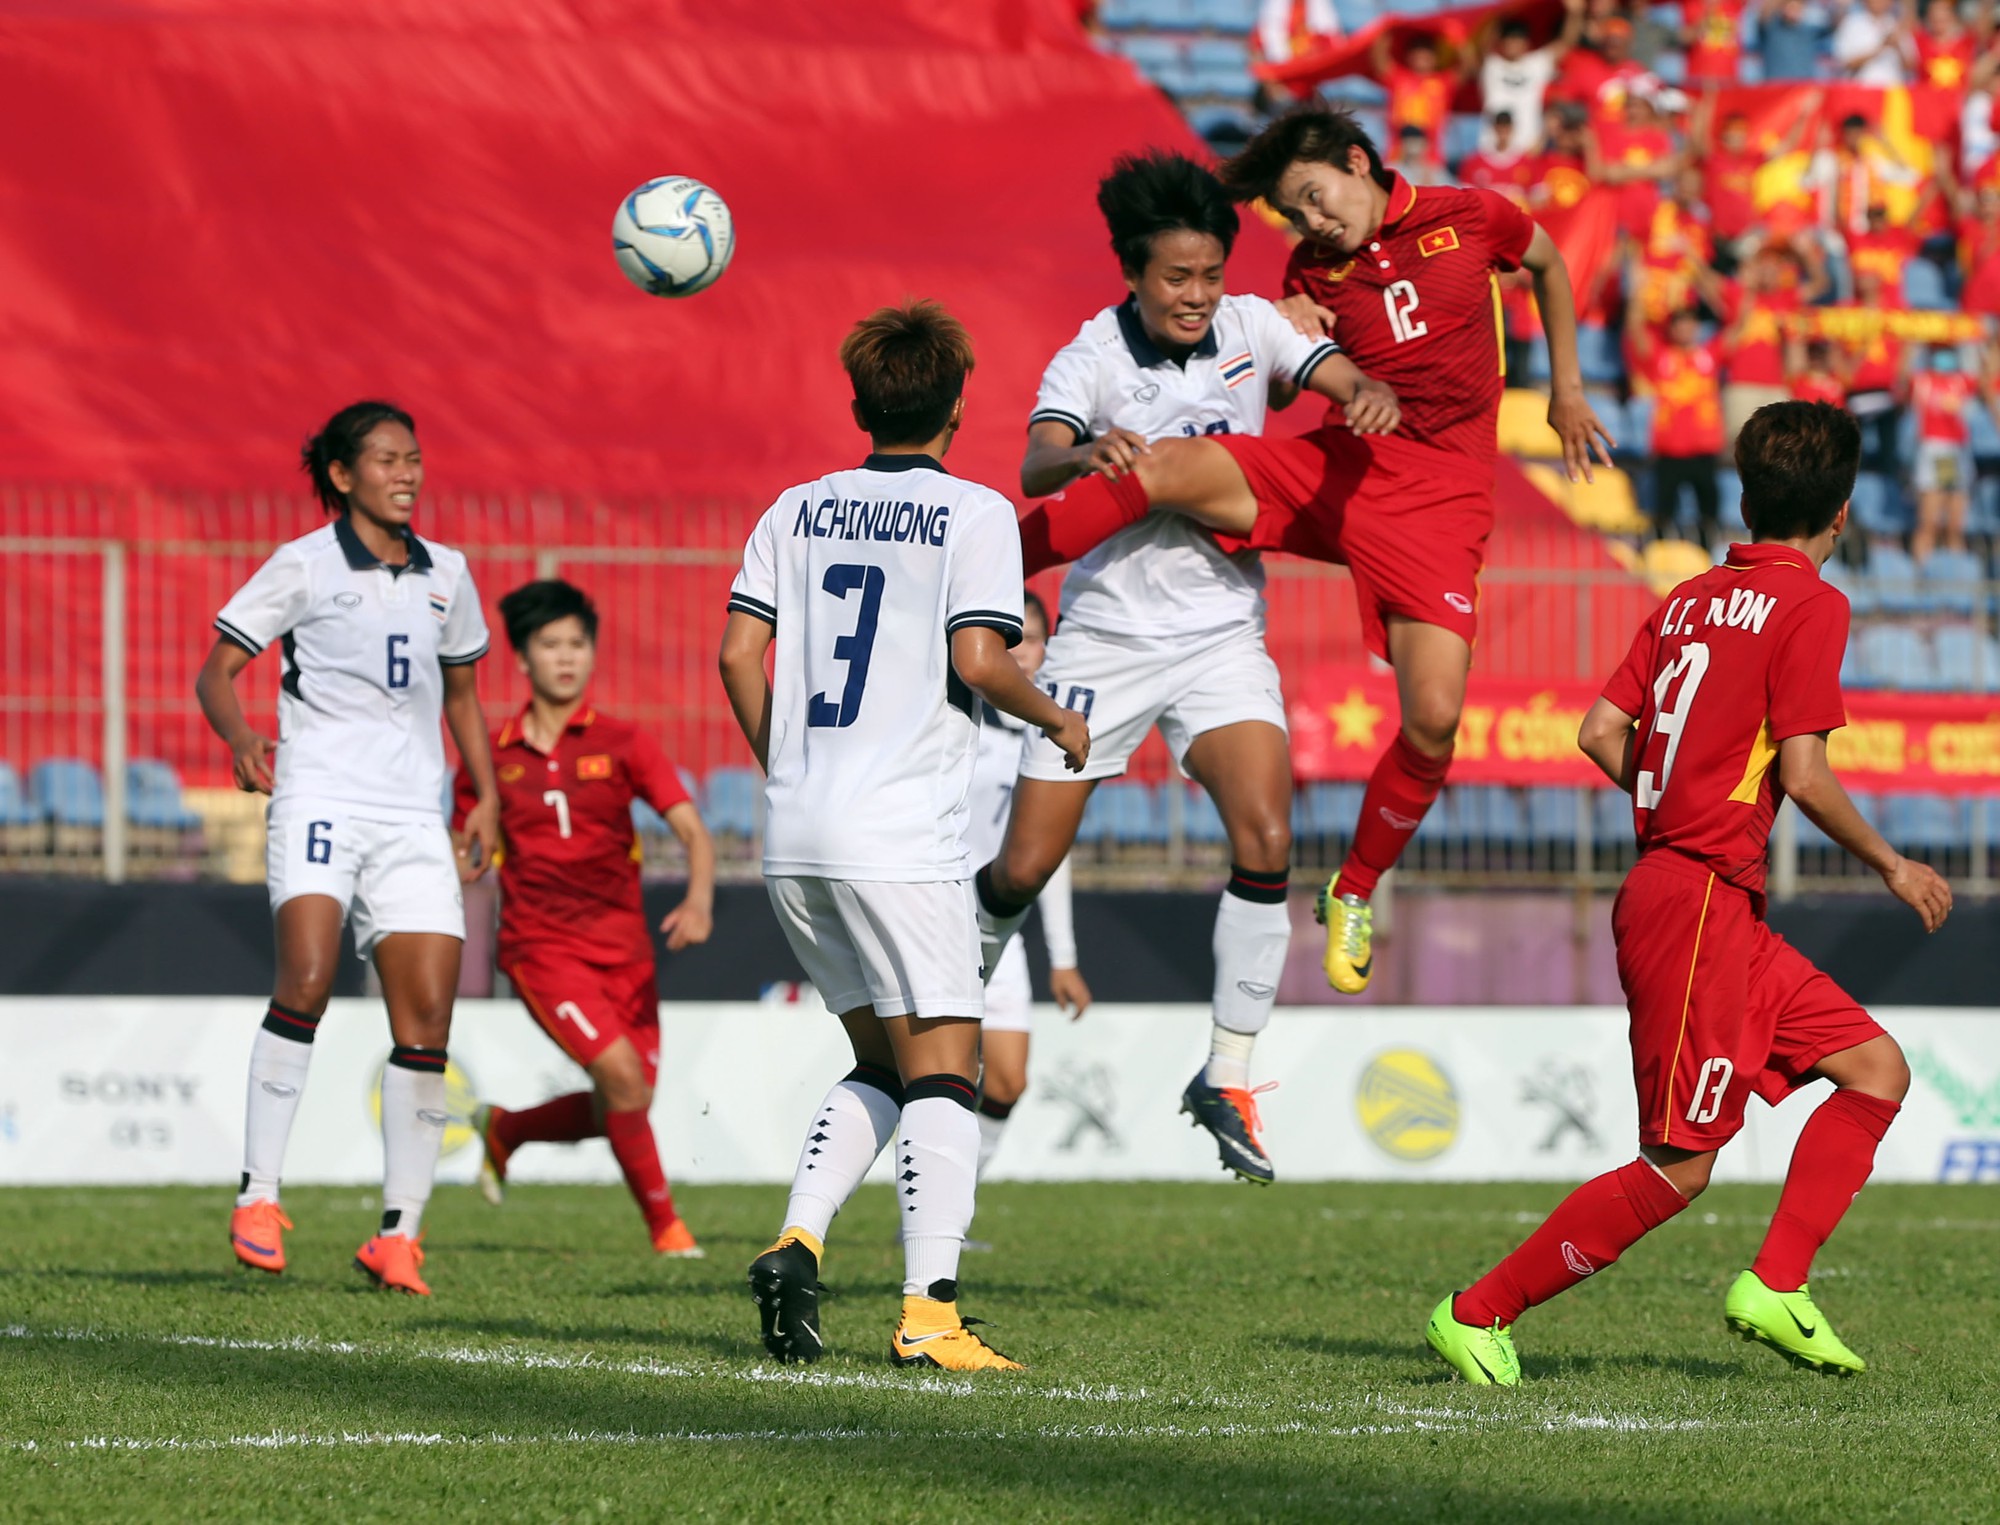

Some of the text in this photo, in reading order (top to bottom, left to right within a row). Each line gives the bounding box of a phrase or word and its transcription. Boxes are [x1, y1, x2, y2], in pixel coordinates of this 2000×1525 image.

[1383, 279, 1428, 344] 12
[386, 634, 410, 688] 6
[807, 563, 886, 728] 3
[305, 820, 333, 866] 6
[1684, 1056, 1735, 1124] 13
